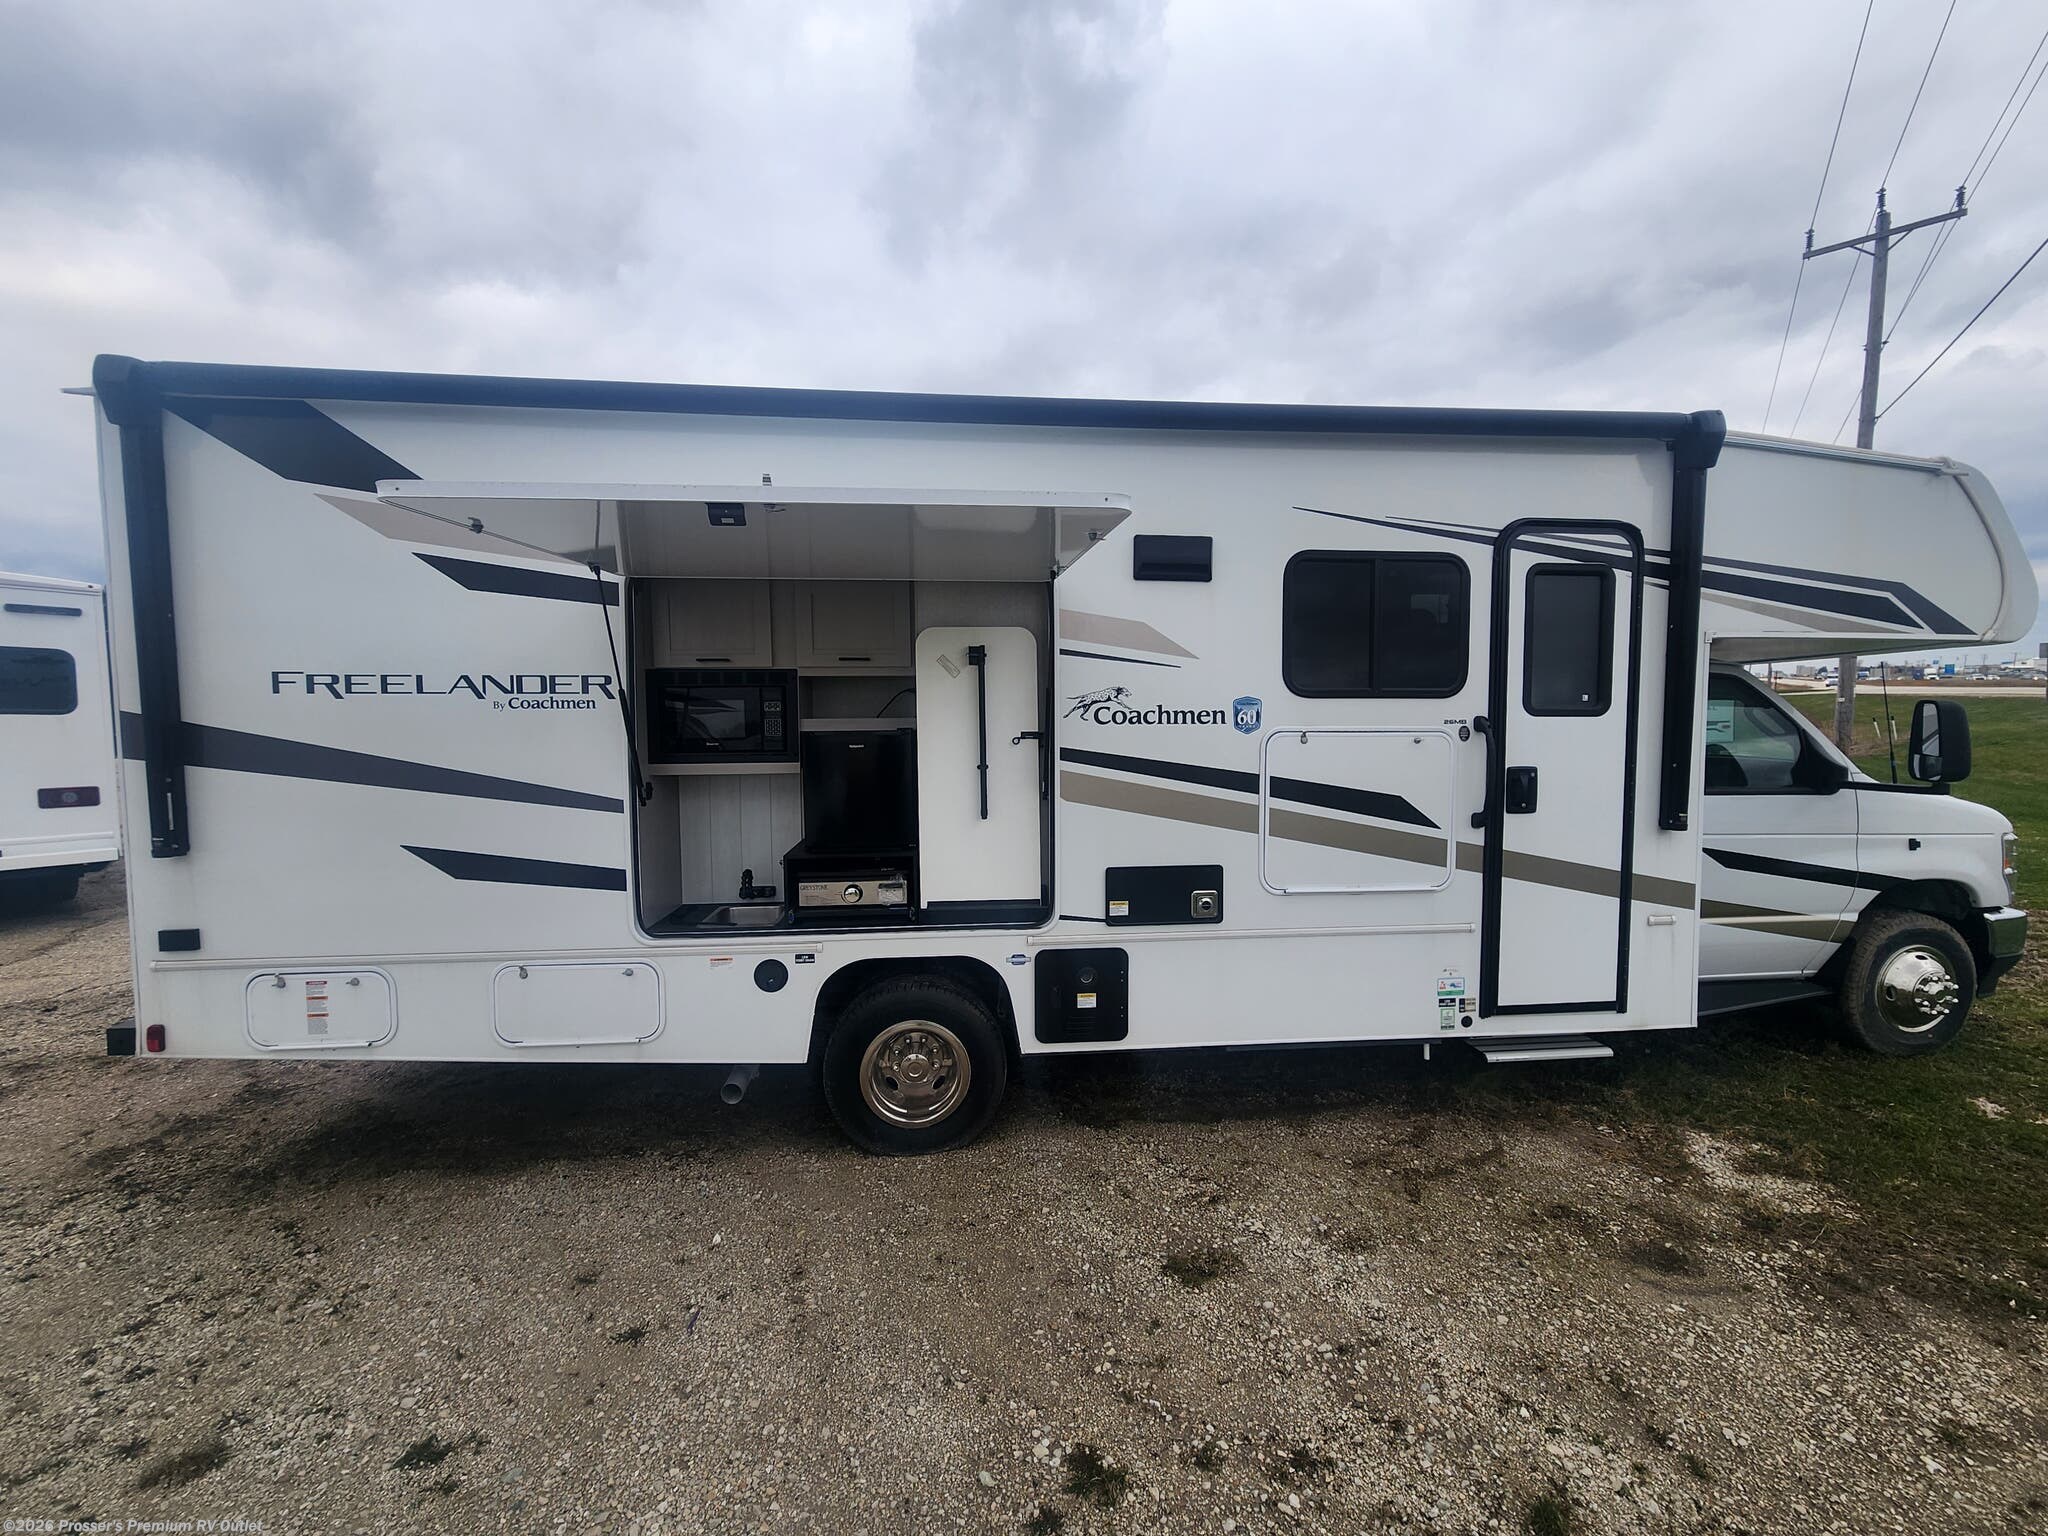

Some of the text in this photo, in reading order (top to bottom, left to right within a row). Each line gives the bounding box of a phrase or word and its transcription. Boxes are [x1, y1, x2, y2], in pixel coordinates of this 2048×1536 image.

[271, 671, 616, 699] FREELANDER
[493, 697, 597, 711] By Coachmen
[1093, 705, 1227, 725] Coachmen
[1237, 709, 1257, 725] 60
